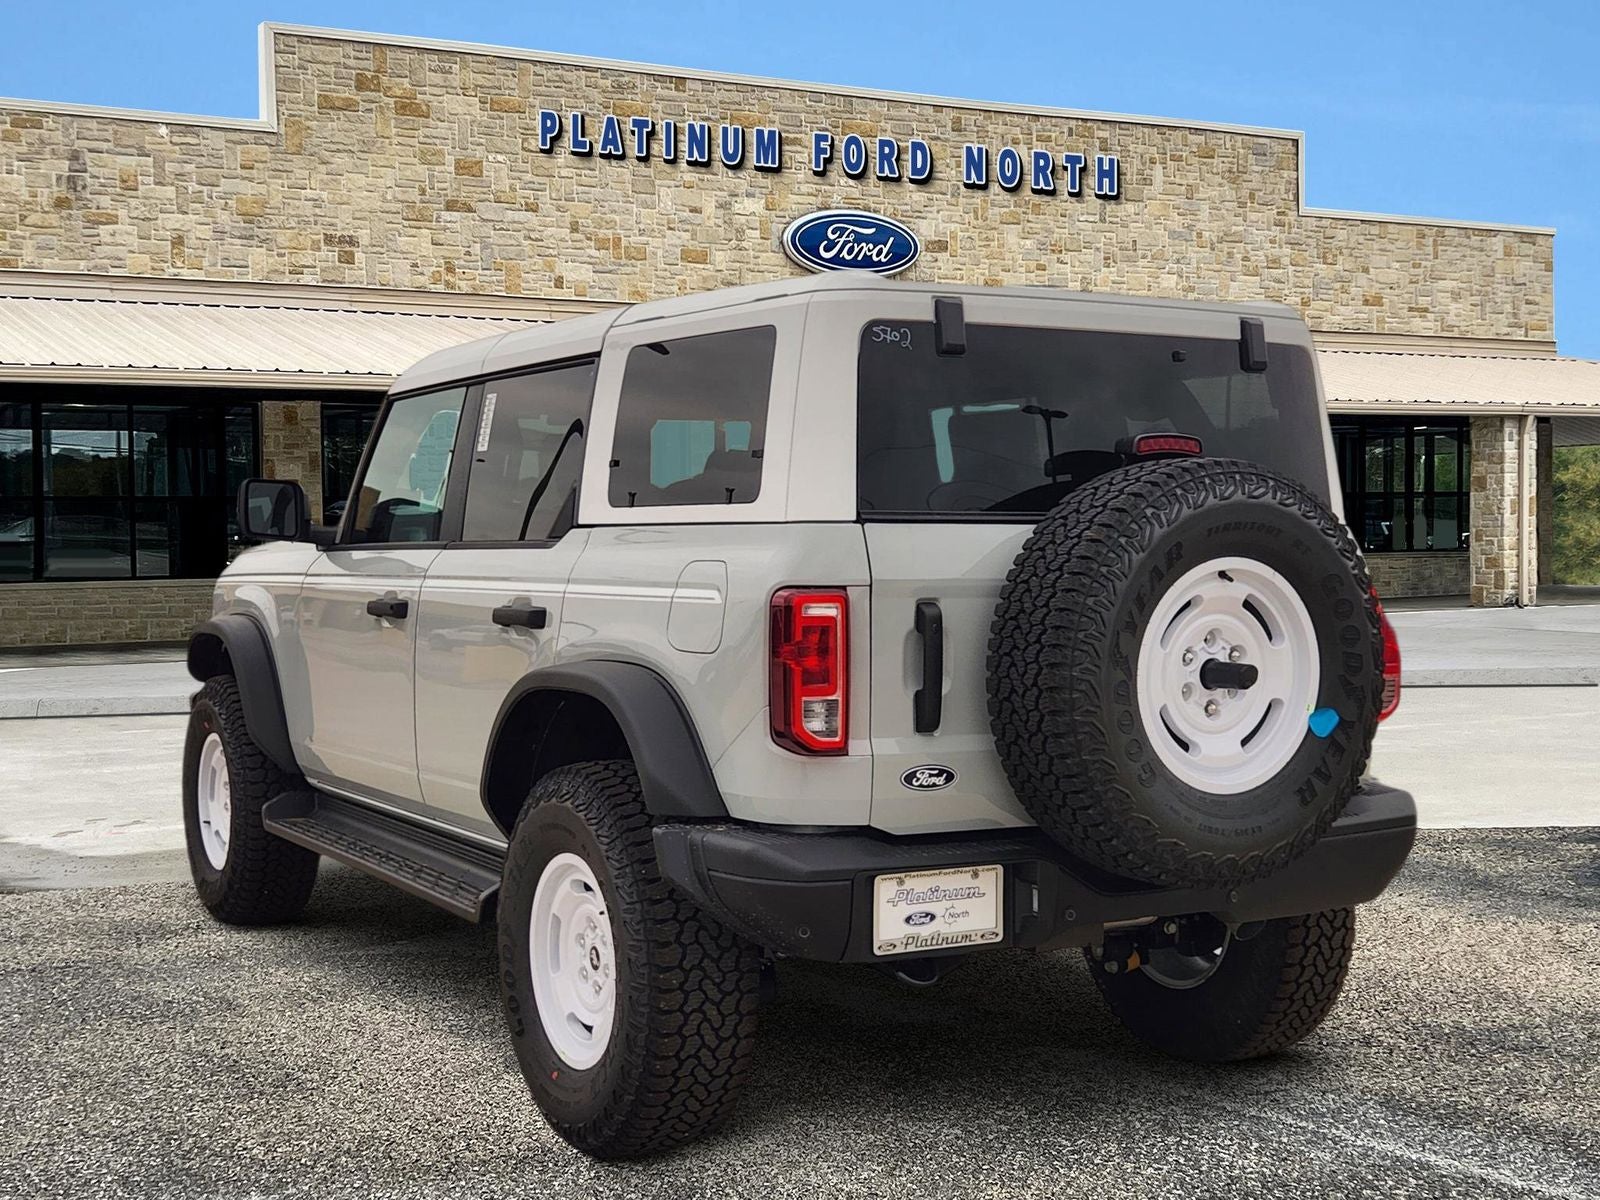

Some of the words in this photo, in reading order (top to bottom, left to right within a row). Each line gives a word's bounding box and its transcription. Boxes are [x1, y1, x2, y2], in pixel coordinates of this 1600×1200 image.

[538, 109, 781, 172] PLATINUM
[812, 133, 933, 185] FORD
[963, 145, 1121, 200] NORTH
[817, 223, 894, 264] Ford
[871, 325, 913, 351] 5702
[1112, 540, 1186, 789] GOODYEAR
[911, 769, 948, 787] Ford
[880, 867, 998, 882] www.PlatinumFordNorth.com
[886, 885, 986, 907] Platinum
[948, 910, 970, 920] North
[903, 932, 977, 951] Platinum
